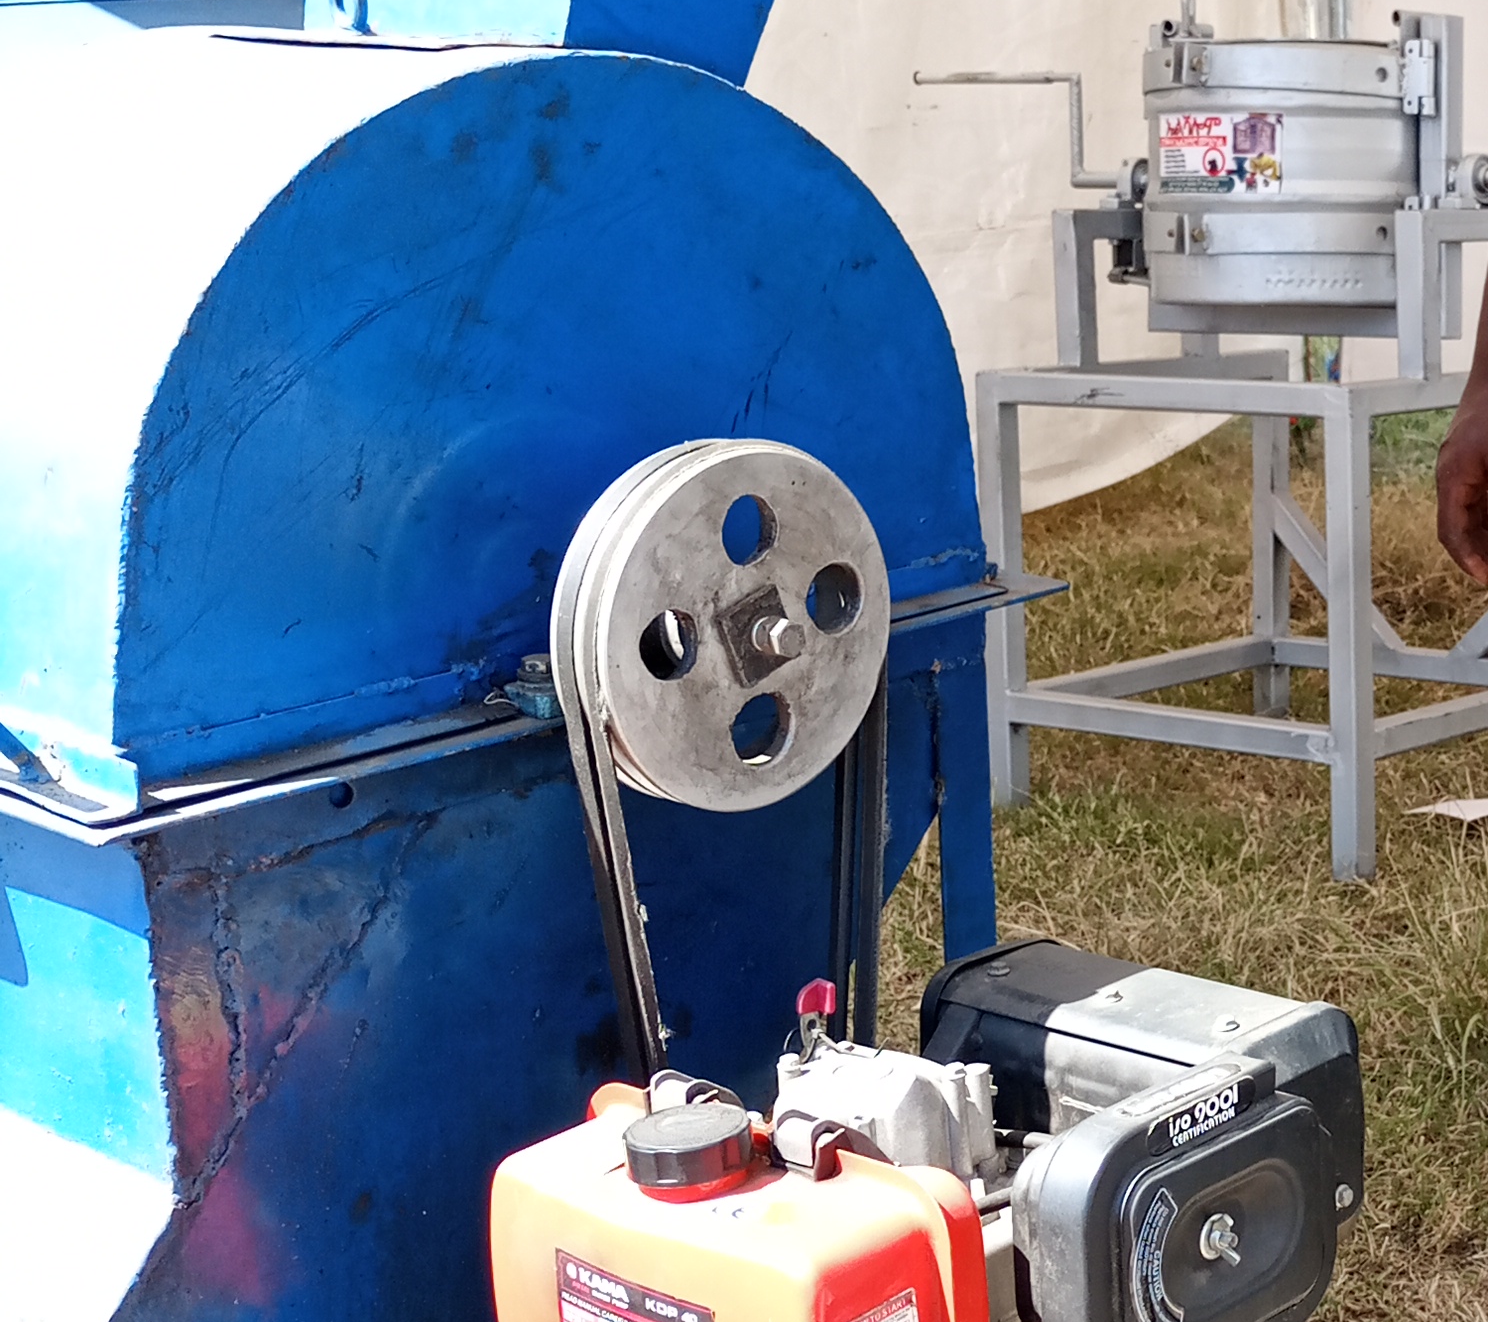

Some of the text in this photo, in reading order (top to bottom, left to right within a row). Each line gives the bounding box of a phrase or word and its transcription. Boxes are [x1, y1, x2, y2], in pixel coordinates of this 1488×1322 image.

[1193, 1084, 1239, 1123] 9001
[1172, 1107, 1236, 1148] CERTIFICATION
[577, 1266, 630, 1304] KAMA
[645, 1297, 678, 1320] KDP
[1152, 1250, 1165, 1302] CAUTION
[881, 1298, 908, 1318] START
